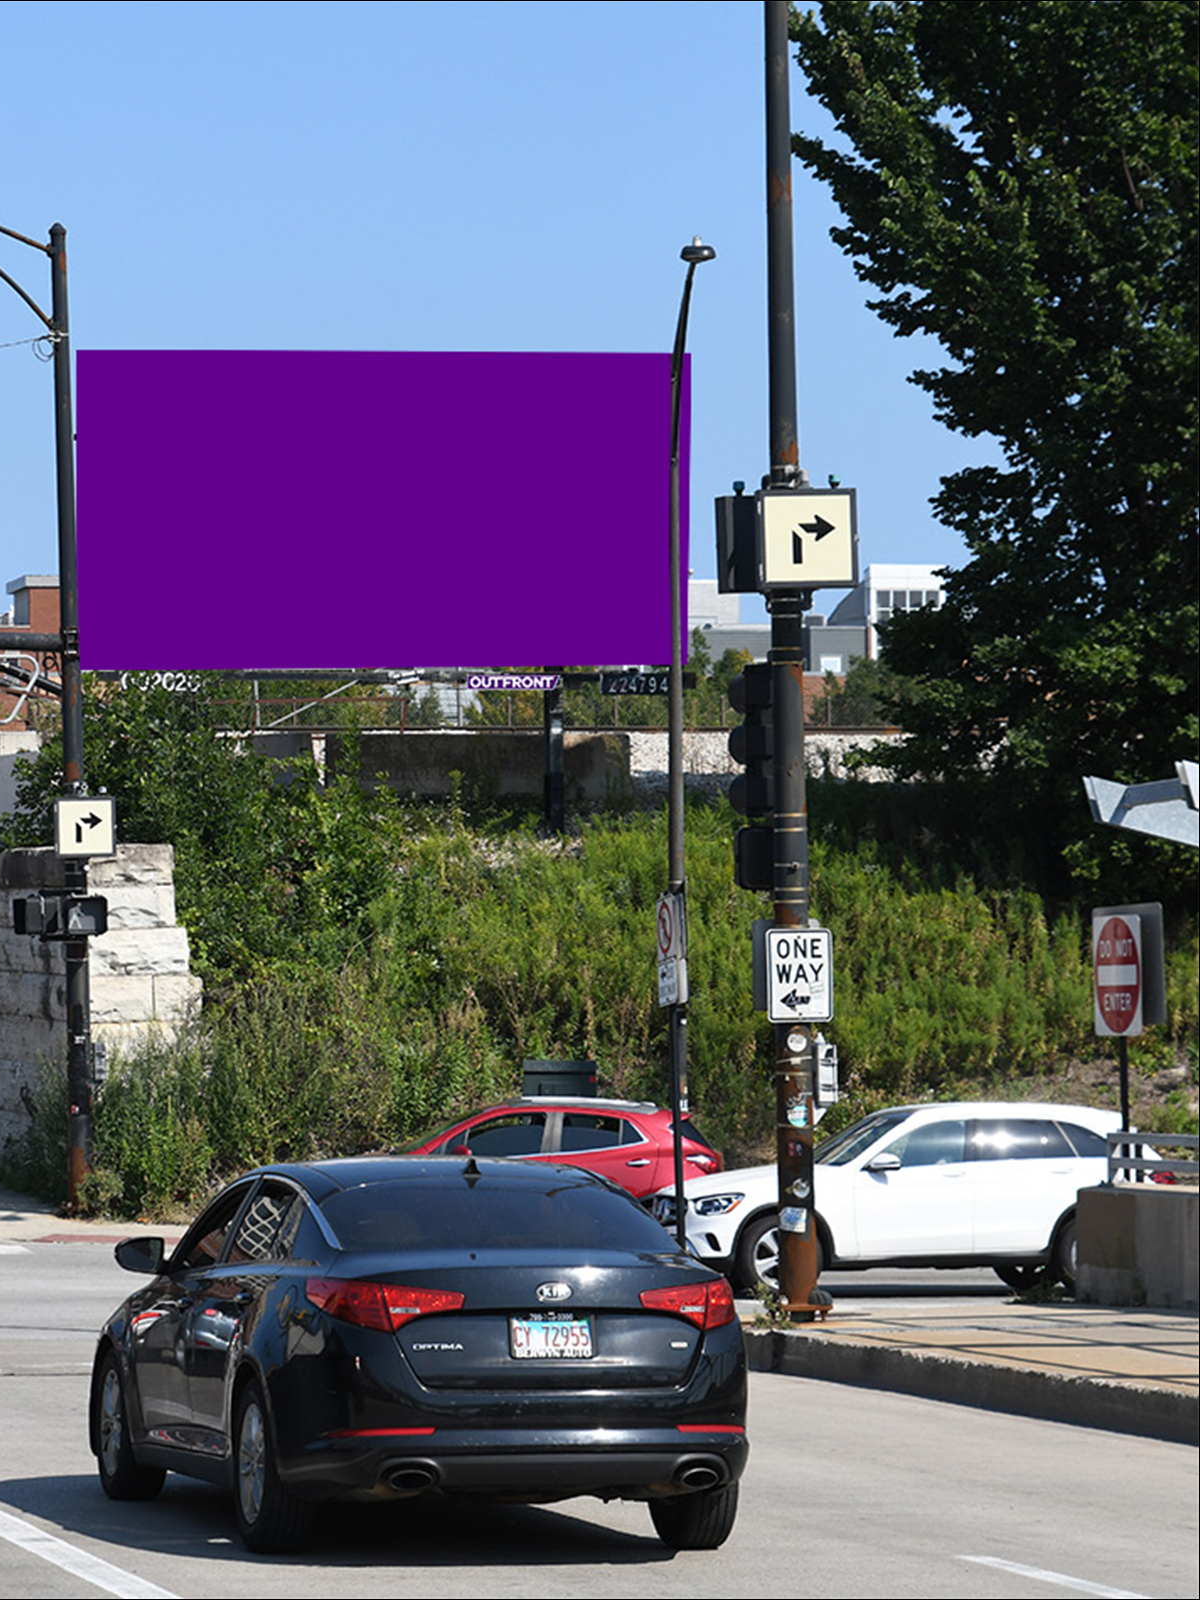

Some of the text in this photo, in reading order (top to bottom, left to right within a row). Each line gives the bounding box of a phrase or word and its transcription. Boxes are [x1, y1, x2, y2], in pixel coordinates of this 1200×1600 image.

[469, 675, 554, 689] OUTFRONT
[776, 939, 823, 959] ONE
[1100, 939, 1133, 957] DO NOT
[776, 963, 824, 984] WAY
[1104, 993, 1132, 1011] ENTER
[513, 1326, 590, 1347] CY 72955
[412, 1343, 464, 1351] OPTIMA
[515, 1348, 592, 1358] BERWYN AUTO
